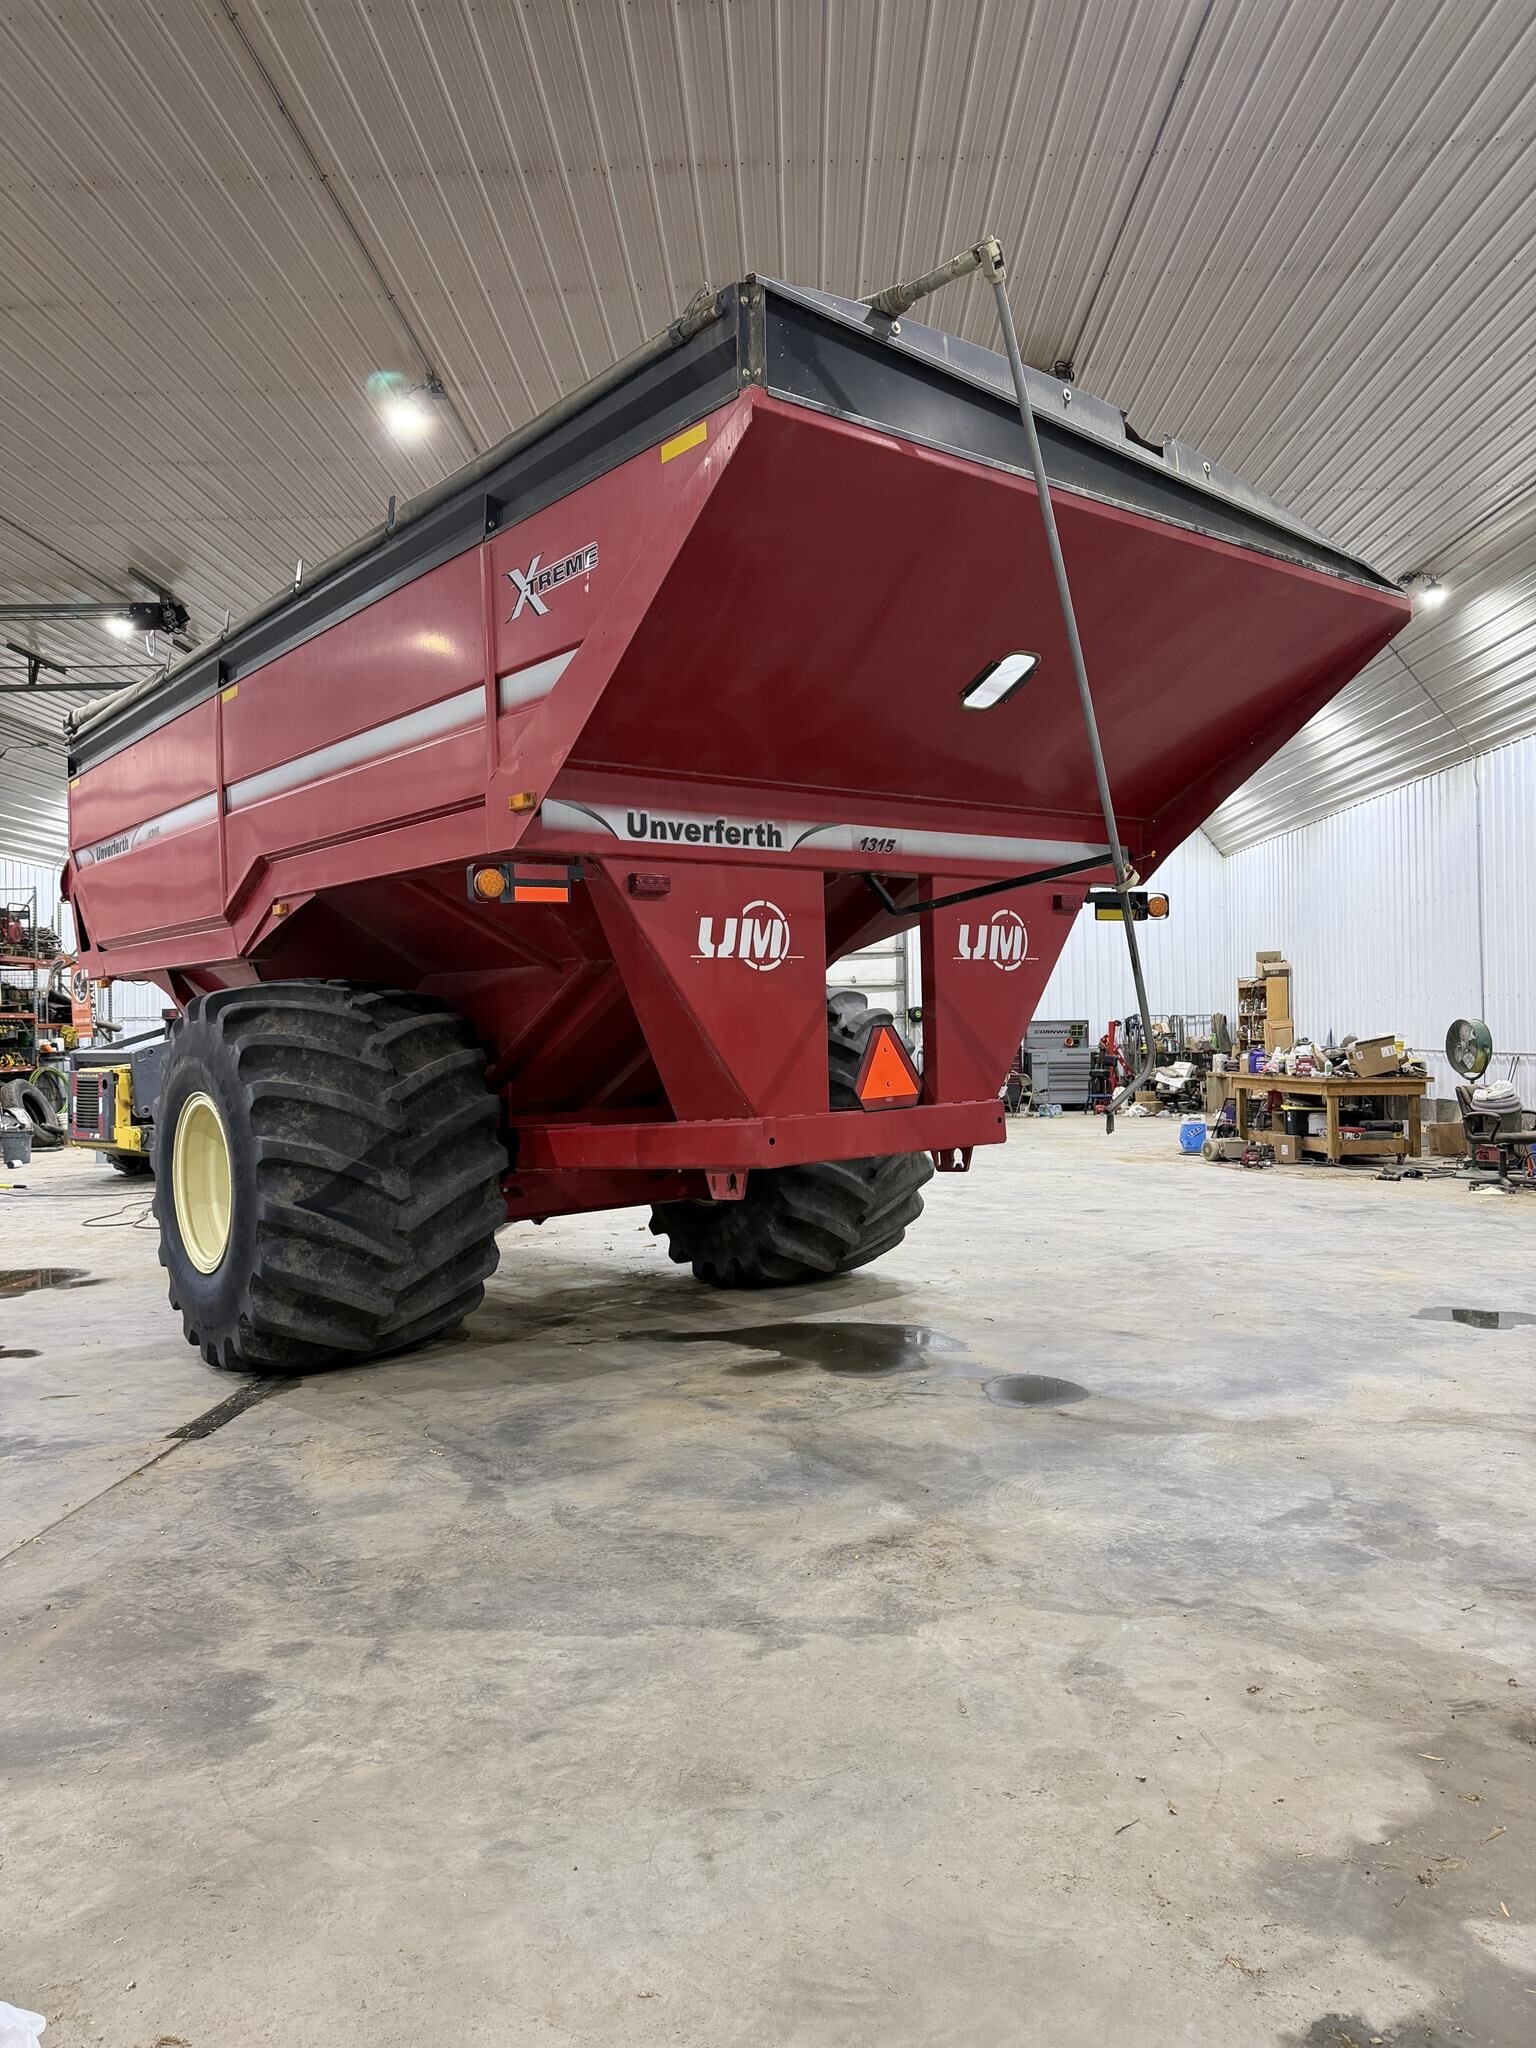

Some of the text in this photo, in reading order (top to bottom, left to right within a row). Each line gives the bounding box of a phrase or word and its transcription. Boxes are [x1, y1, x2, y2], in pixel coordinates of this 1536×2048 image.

[503, 543, 598, 623] XTREME
[96, 834, 129, 861] Unverferth
[626, 810, 897, 853] Unverferth 1315
